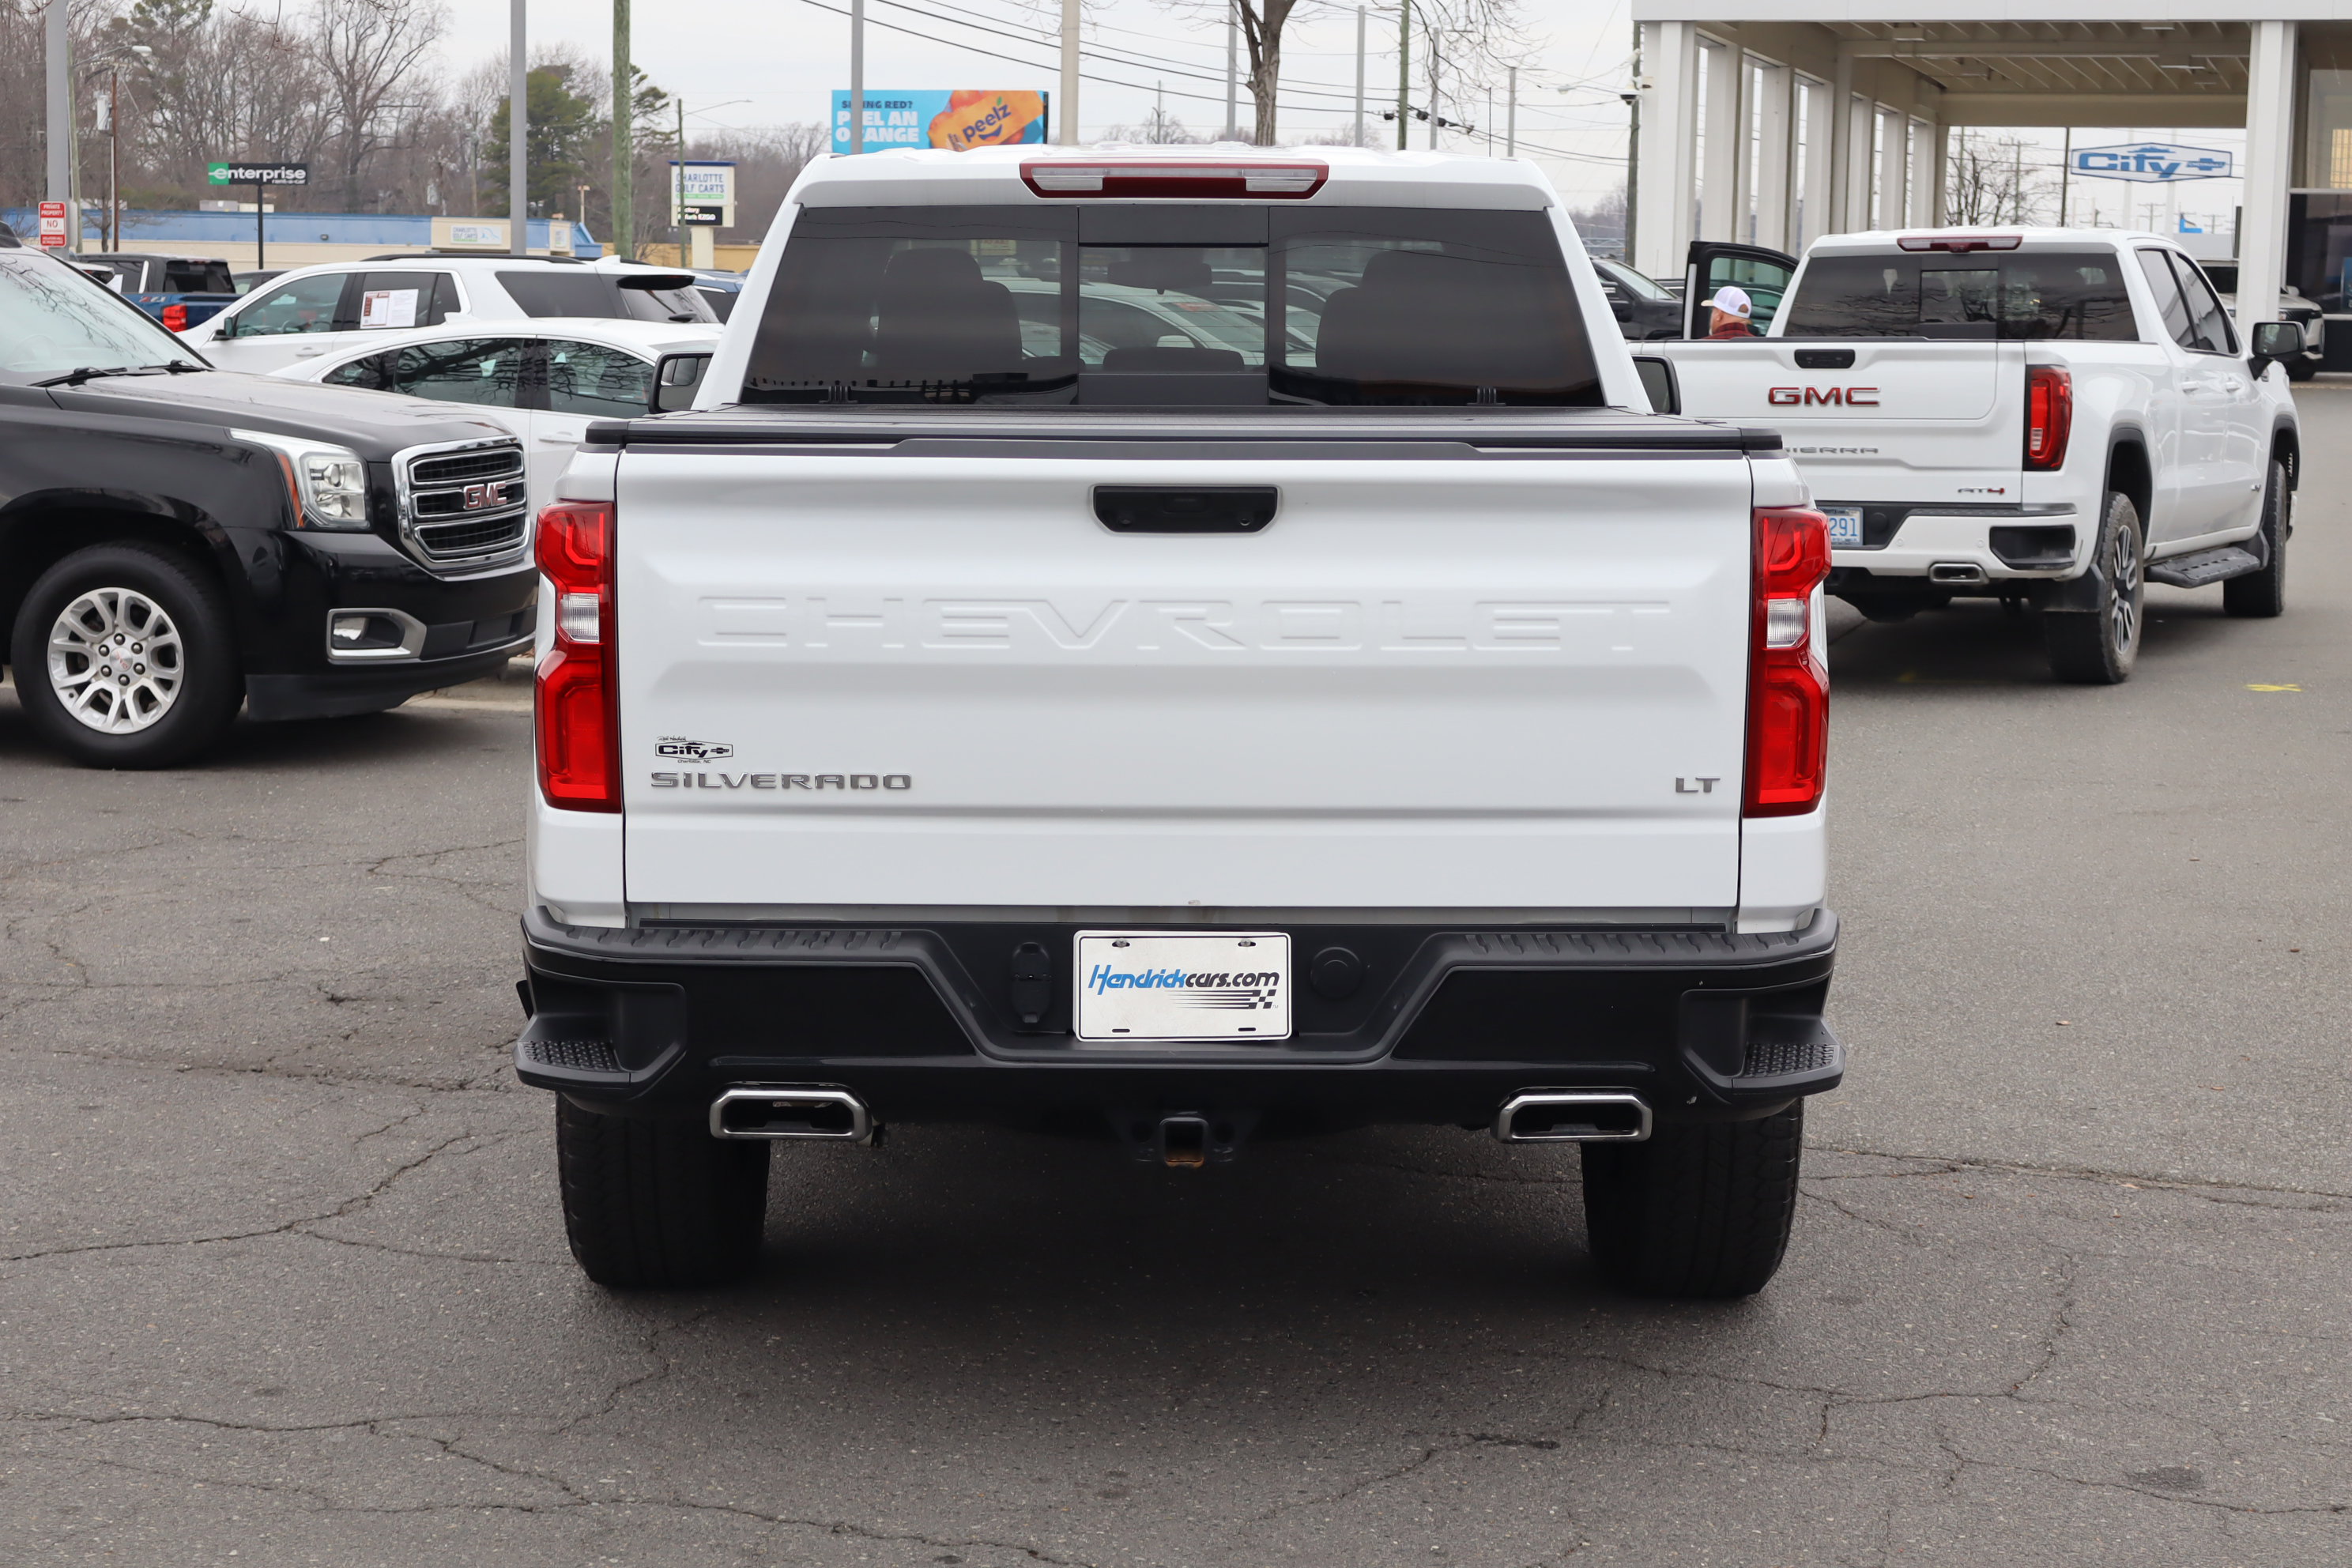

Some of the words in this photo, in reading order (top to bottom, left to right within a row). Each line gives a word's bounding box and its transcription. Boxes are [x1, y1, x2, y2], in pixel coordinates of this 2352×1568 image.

[837, 111, 884, 126] PEL
[888, 111, 918, 126] AN
[963, 104, 1012, 142] peelz
[835, 126, 919, 142] OANGE
[208, 166, 307, 183] enterprise
[2079, 153, 2180, 179] City
[698, 184, 725, 193] CARTS
[47, 219, 58, 228] NO
[1768, 386, 1881, 406] GMC
[463, 481, 507, 511] GMC
[1958, 487, 2005, 496] AT4
[1829, 518, 1858, 537] 291
[696, 596, 1671, 651] CHEVROLET
[658, 745, 709, 758] City
[650, 771, 912, 790] SILVERADO
[1675, 777, 1721, 793] LT
[1087, 964, 1280, 996] Hendrickcars.com
